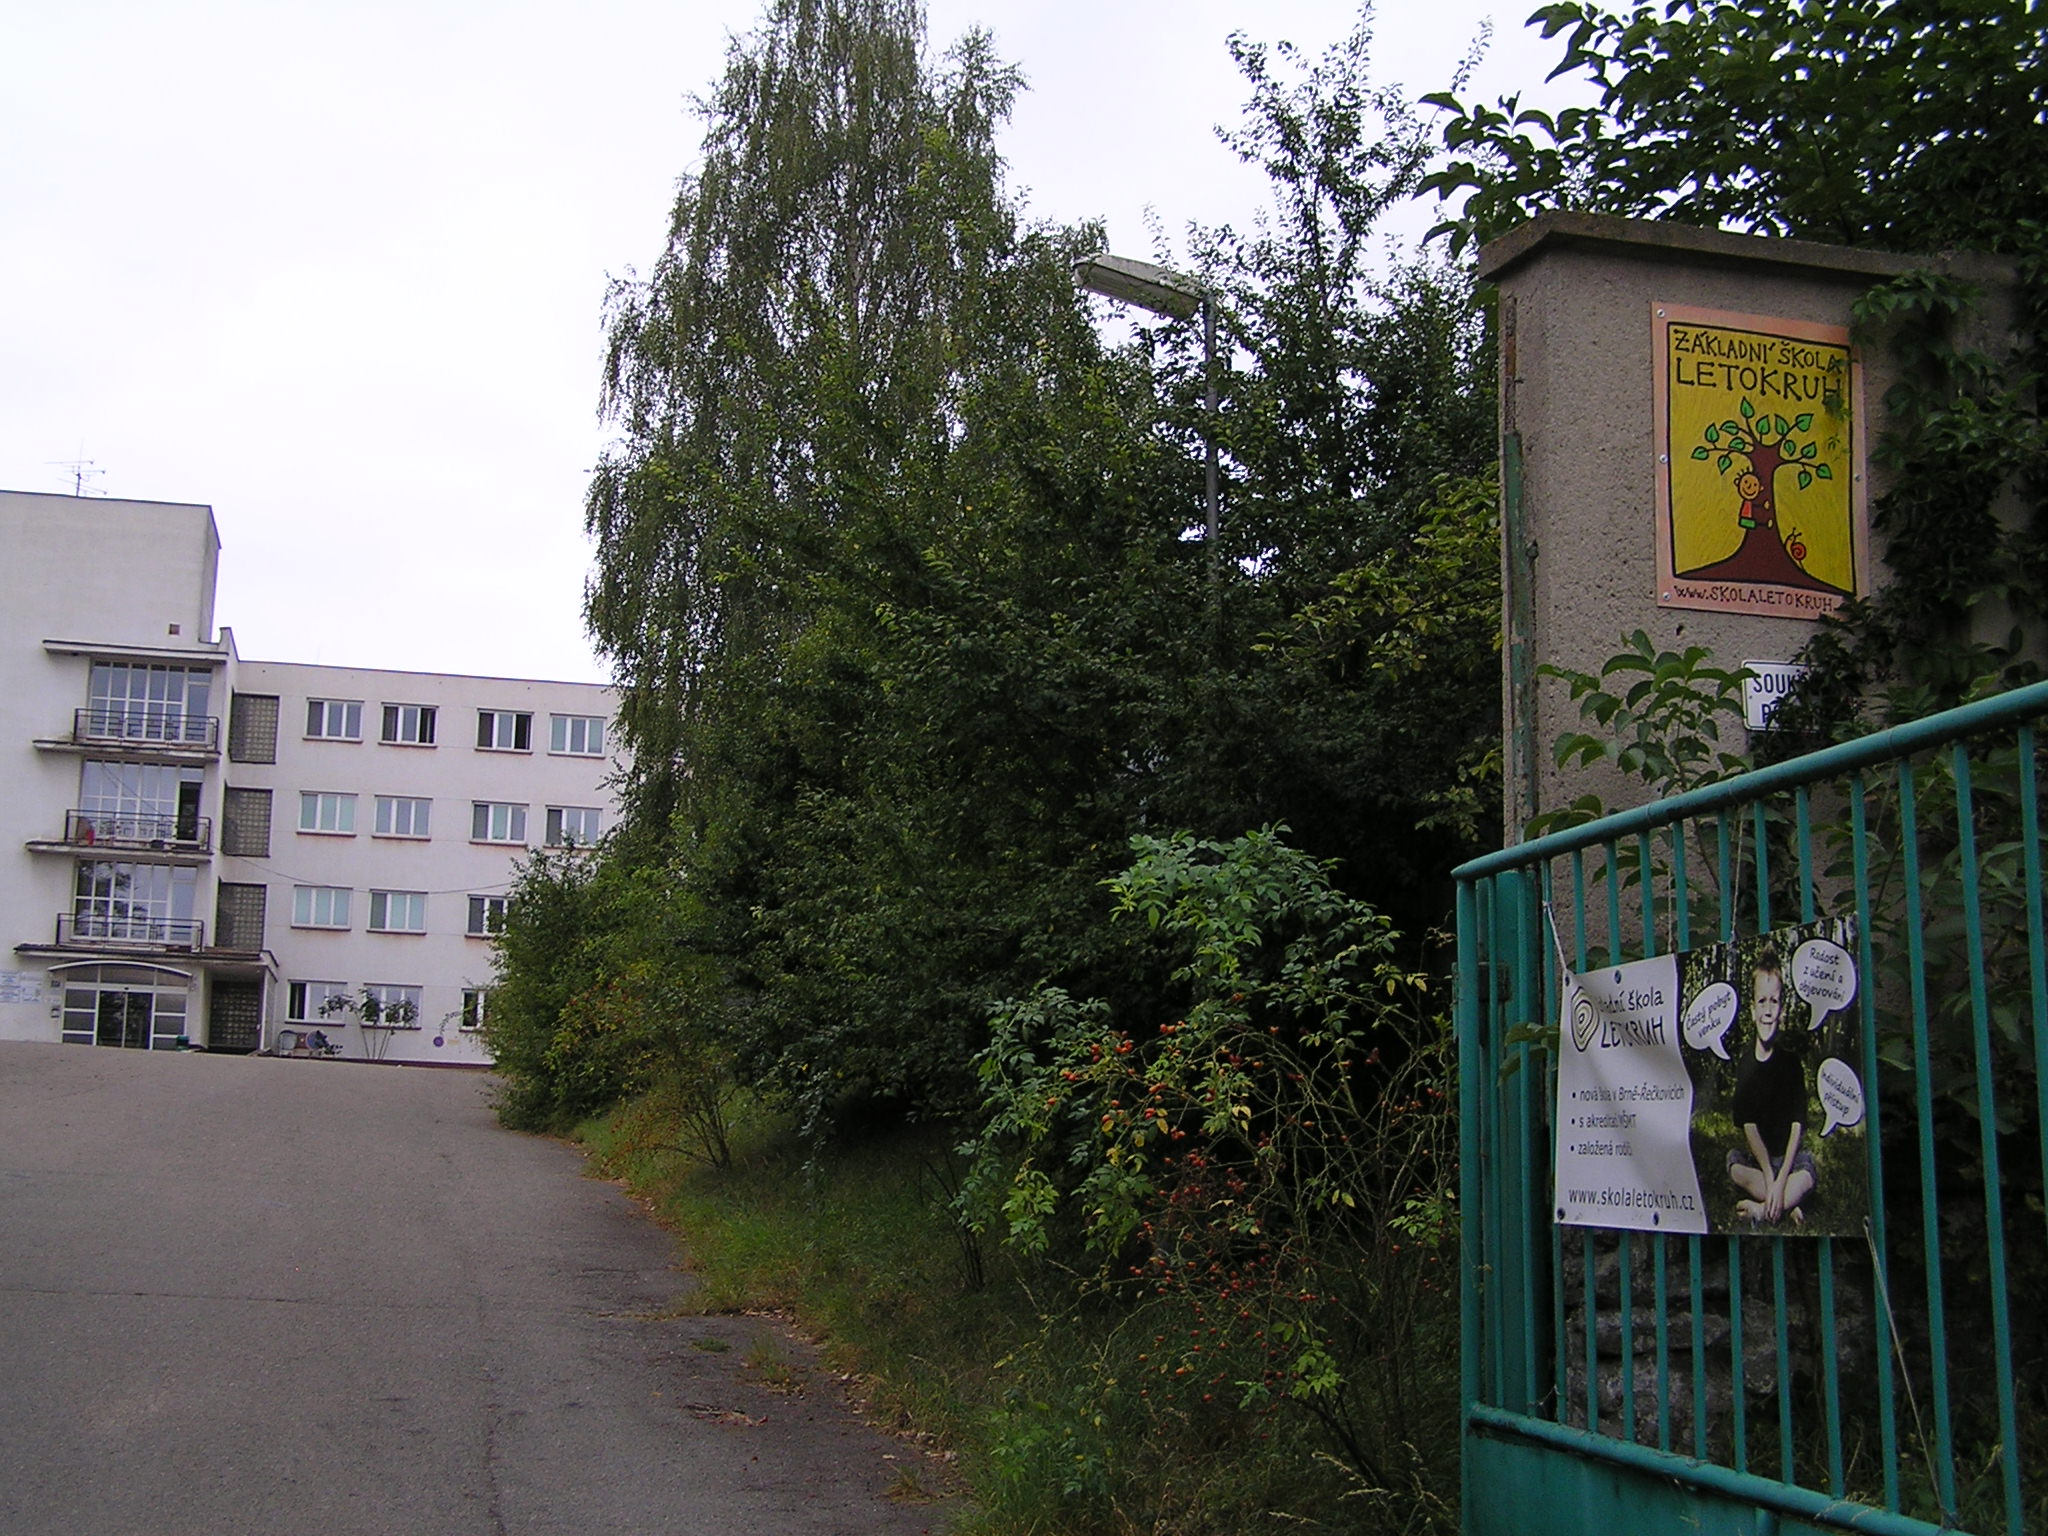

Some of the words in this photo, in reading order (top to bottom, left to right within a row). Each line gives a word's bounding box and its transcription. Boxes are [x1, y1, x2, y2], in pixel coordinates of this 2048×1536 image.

[1673, 329, 1776, 364] ZÁKLADNÍ
[1778, 341, 1842, 374] ŠKOLA
[1676, 357, 1842, 405] LETOKRUH
[1753, 673, 1799, 694] SOUK
[1810, 947, 1839, 965] Radost
[1628, 986, 1664, 1011] škola
[1568, 1186, 1695, 1211] www.skolaletokruh.cz
